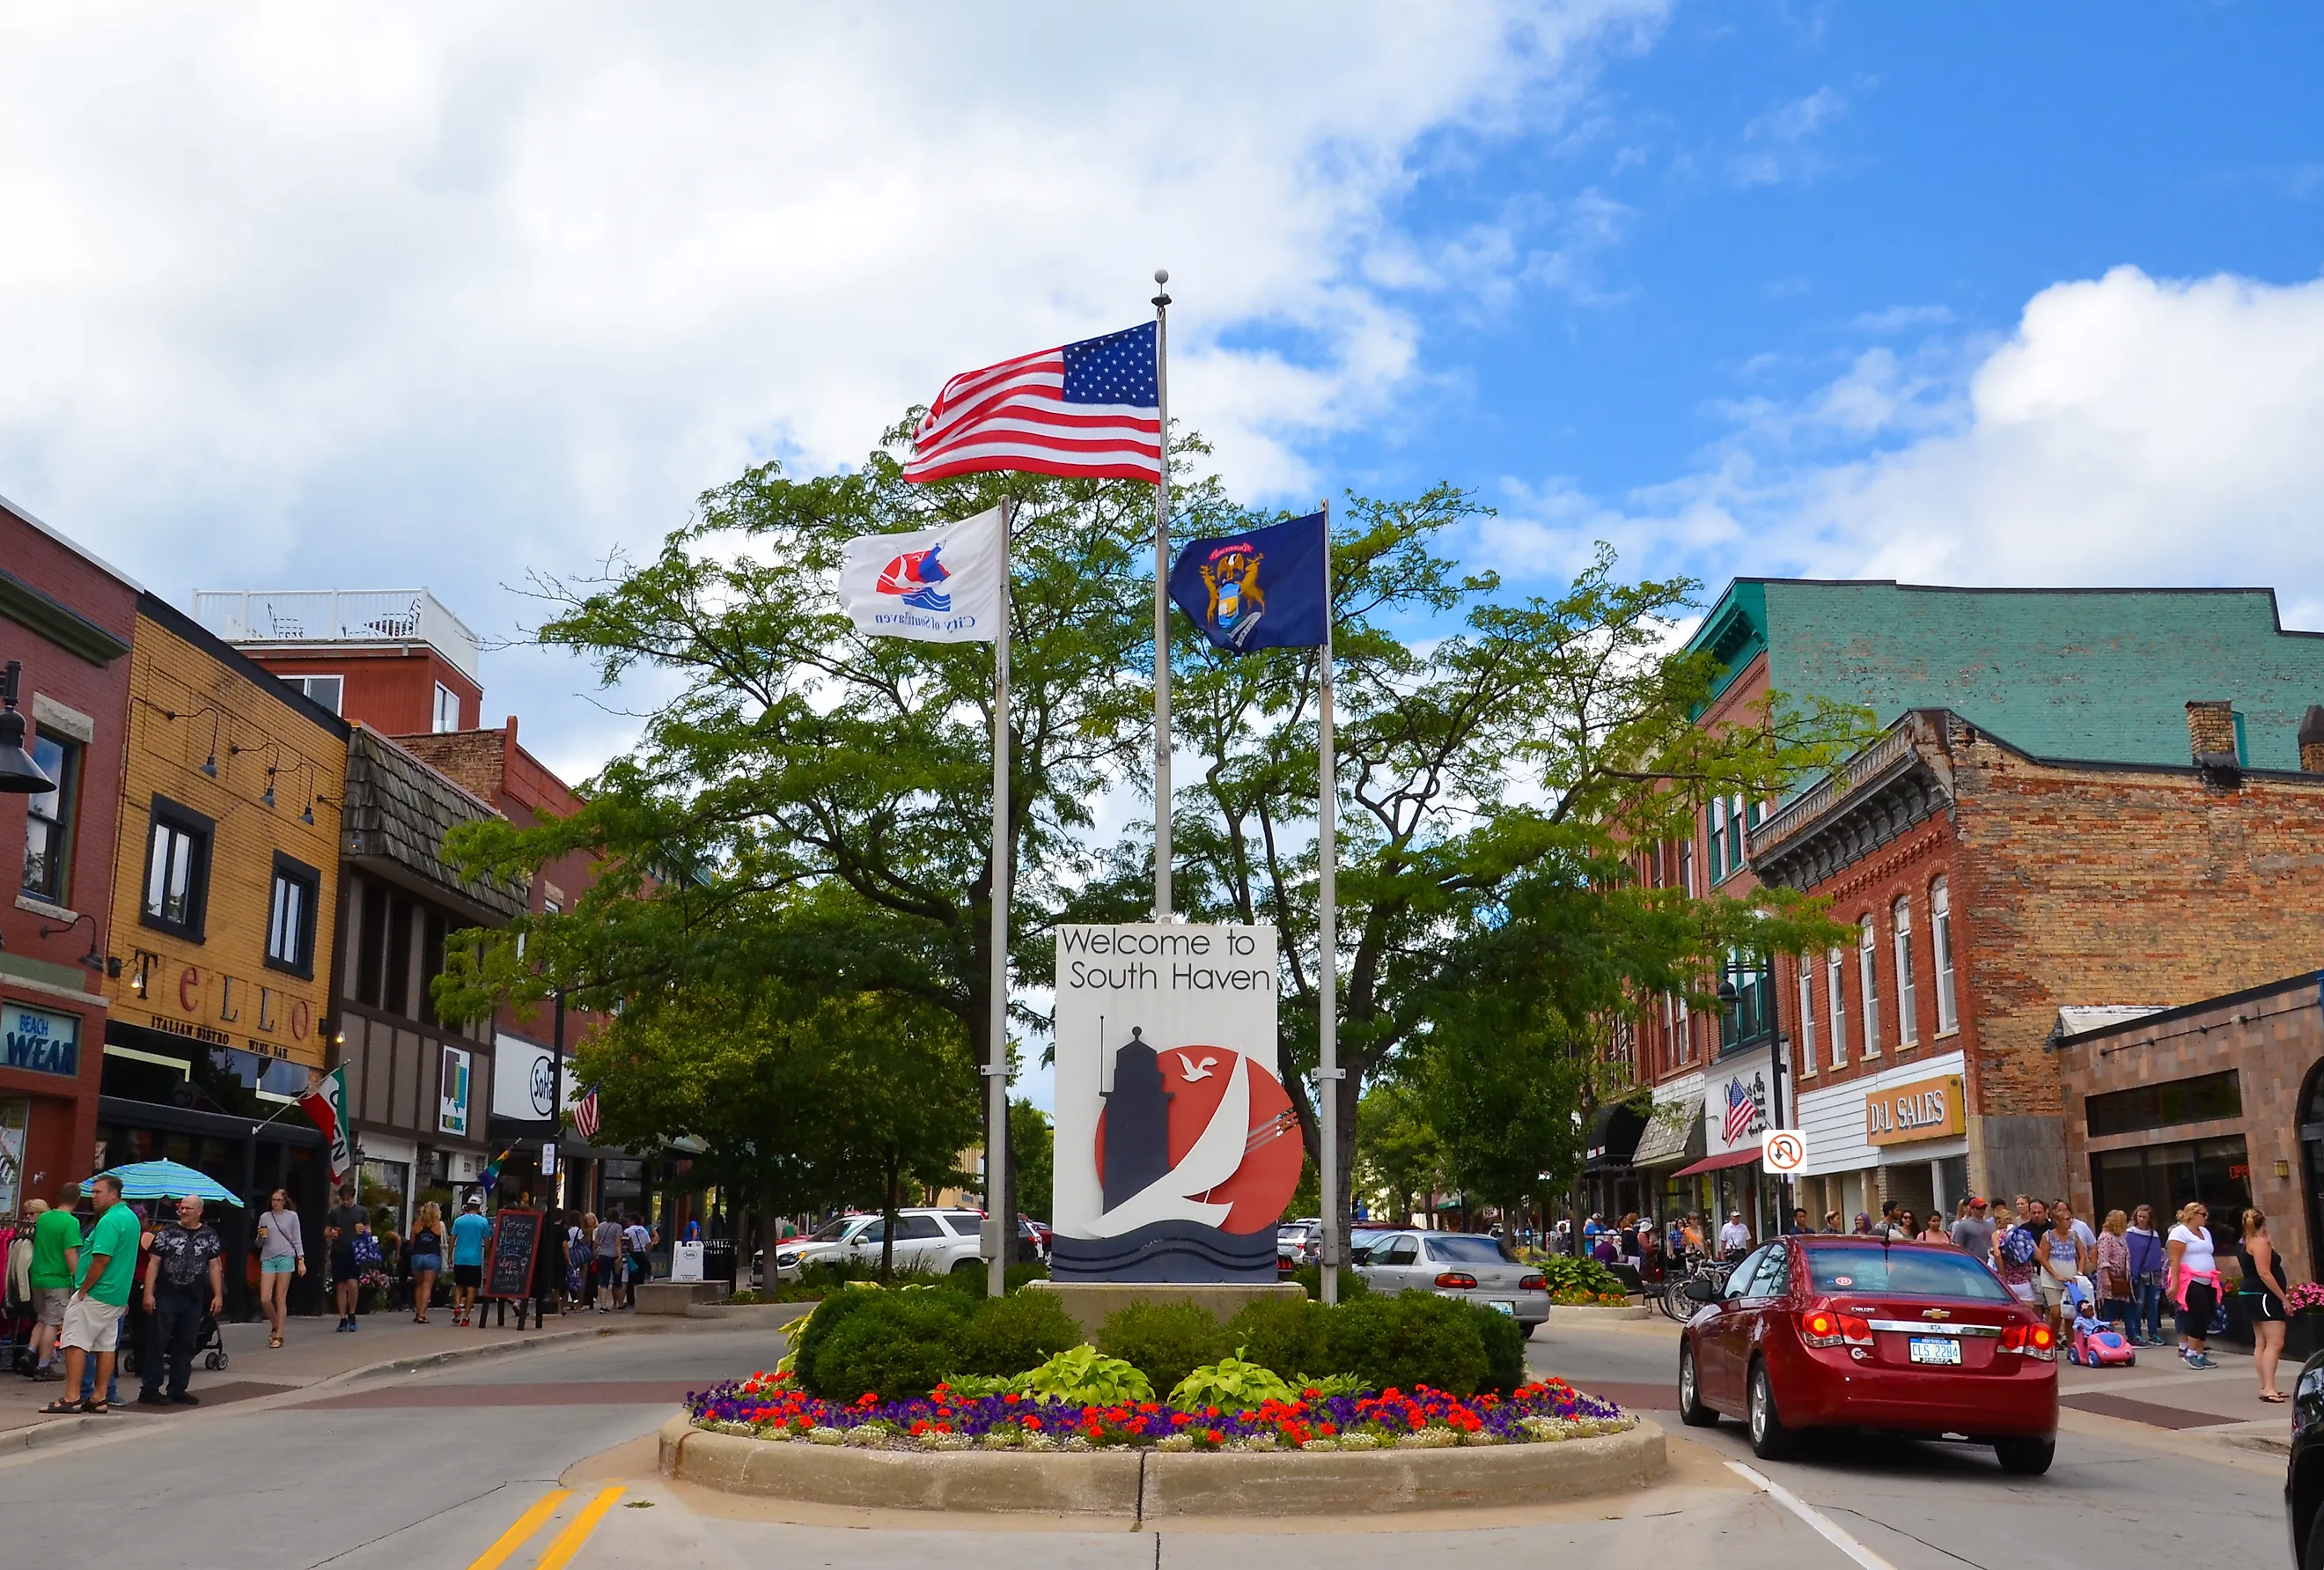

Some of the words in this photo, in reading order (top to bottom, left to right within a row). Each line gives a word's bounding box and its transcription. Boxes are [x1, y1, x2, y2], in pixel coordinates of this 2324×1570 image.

[1062, 927, 1210, 955] Welcome
[1226, 928, 1255, 956] to
[1070, 961, 1158, 990] South
[1173, 962, 1270, 991] Haven
[19, 1013, 49, 1036] BEACH
[151, 1015, 193, 1036] ITALIAN
[195, 1026, 230, 1045] BISTRO
[248, 1039, 269, 1055] WINE
[274, 1046, 289, 1059] BAR
[1896, 1089, 1945, 1131] SALES
[1912, 1344, 1930, 1357] CLS
[1935, 1345, 1958, 1359] 2284
